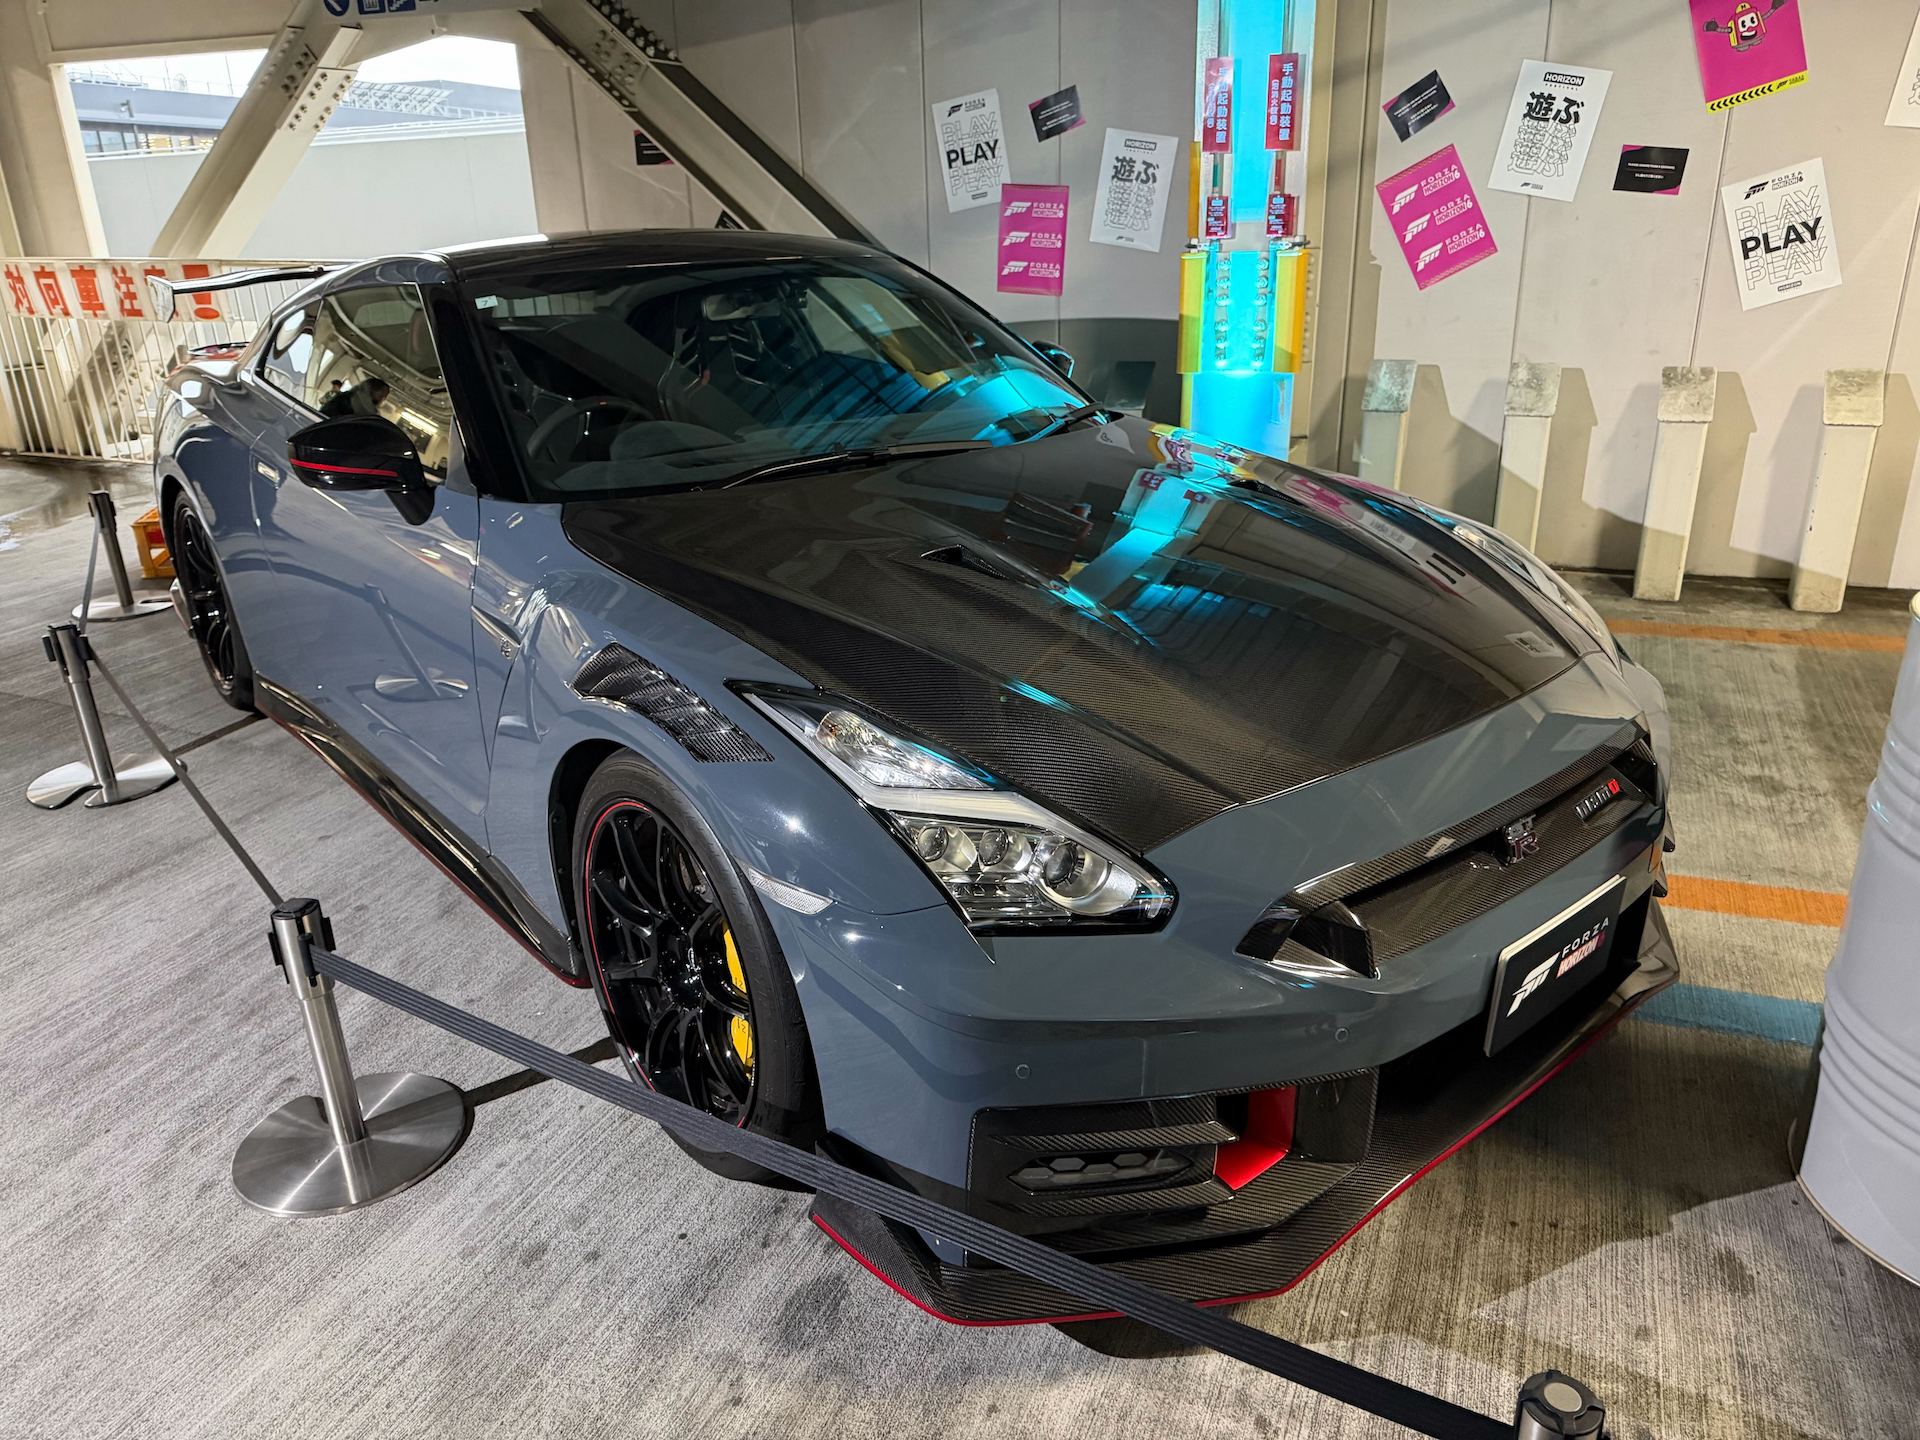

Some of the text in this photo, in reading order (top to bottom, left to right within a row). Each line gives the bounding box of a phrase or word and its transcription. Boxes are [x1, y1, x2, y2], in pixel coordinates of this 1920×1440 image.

[1545, 73, 1583, 85] HORIZON
[1523, 91, 1584, 124] 遊ぶ
[946, 139, 998, 169] PLAY
[1111, 156, 1159, 184] 遊ぶ
[1421, 164, 1458, 187] FORZA
[1772, 171, 1803, 183] FORZA
[1423, 173, 1454, 196] HORIZON
[1433, 193, 1470, 216] FORZA
[1435, 202, 1466, 225] HORIZON
[1445, 223, 1482, 245] FORZA
[1447, 231, 1478, 254] HORIZON
[1741, 216, 1822, 260] PLAY
[4, 263, 220, 320] 対向車注!
[1562, 917, 1609, 958] FORZA
[1556, 934, 1600, 978] HORIZON
